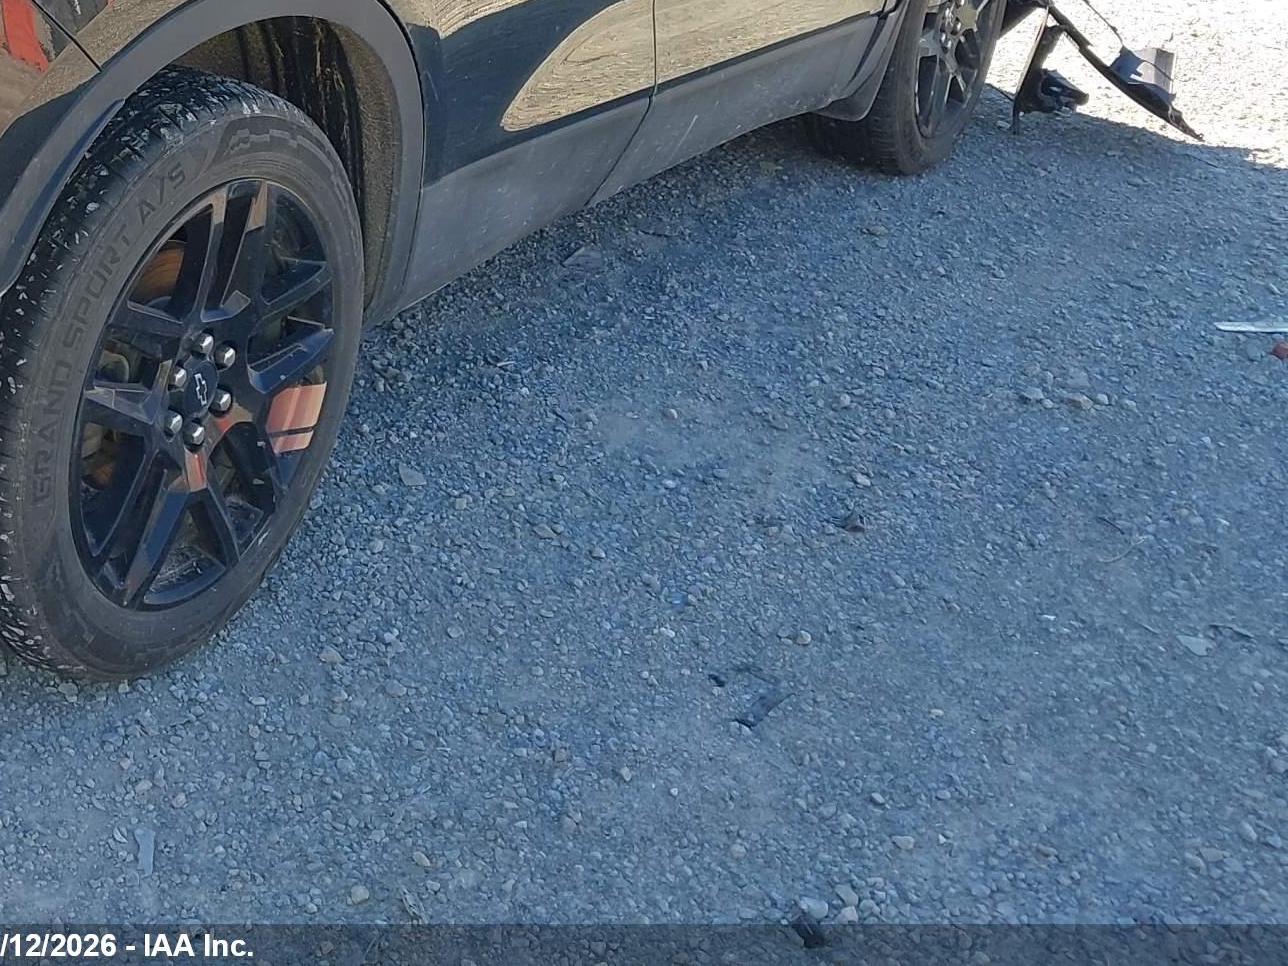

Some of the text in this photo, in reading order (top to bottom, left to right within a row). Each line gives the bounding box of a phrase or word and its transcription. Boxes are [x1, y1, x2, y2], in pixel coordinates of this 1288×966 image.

[32, 162, 187, 504] GRAND SPORT A/S
